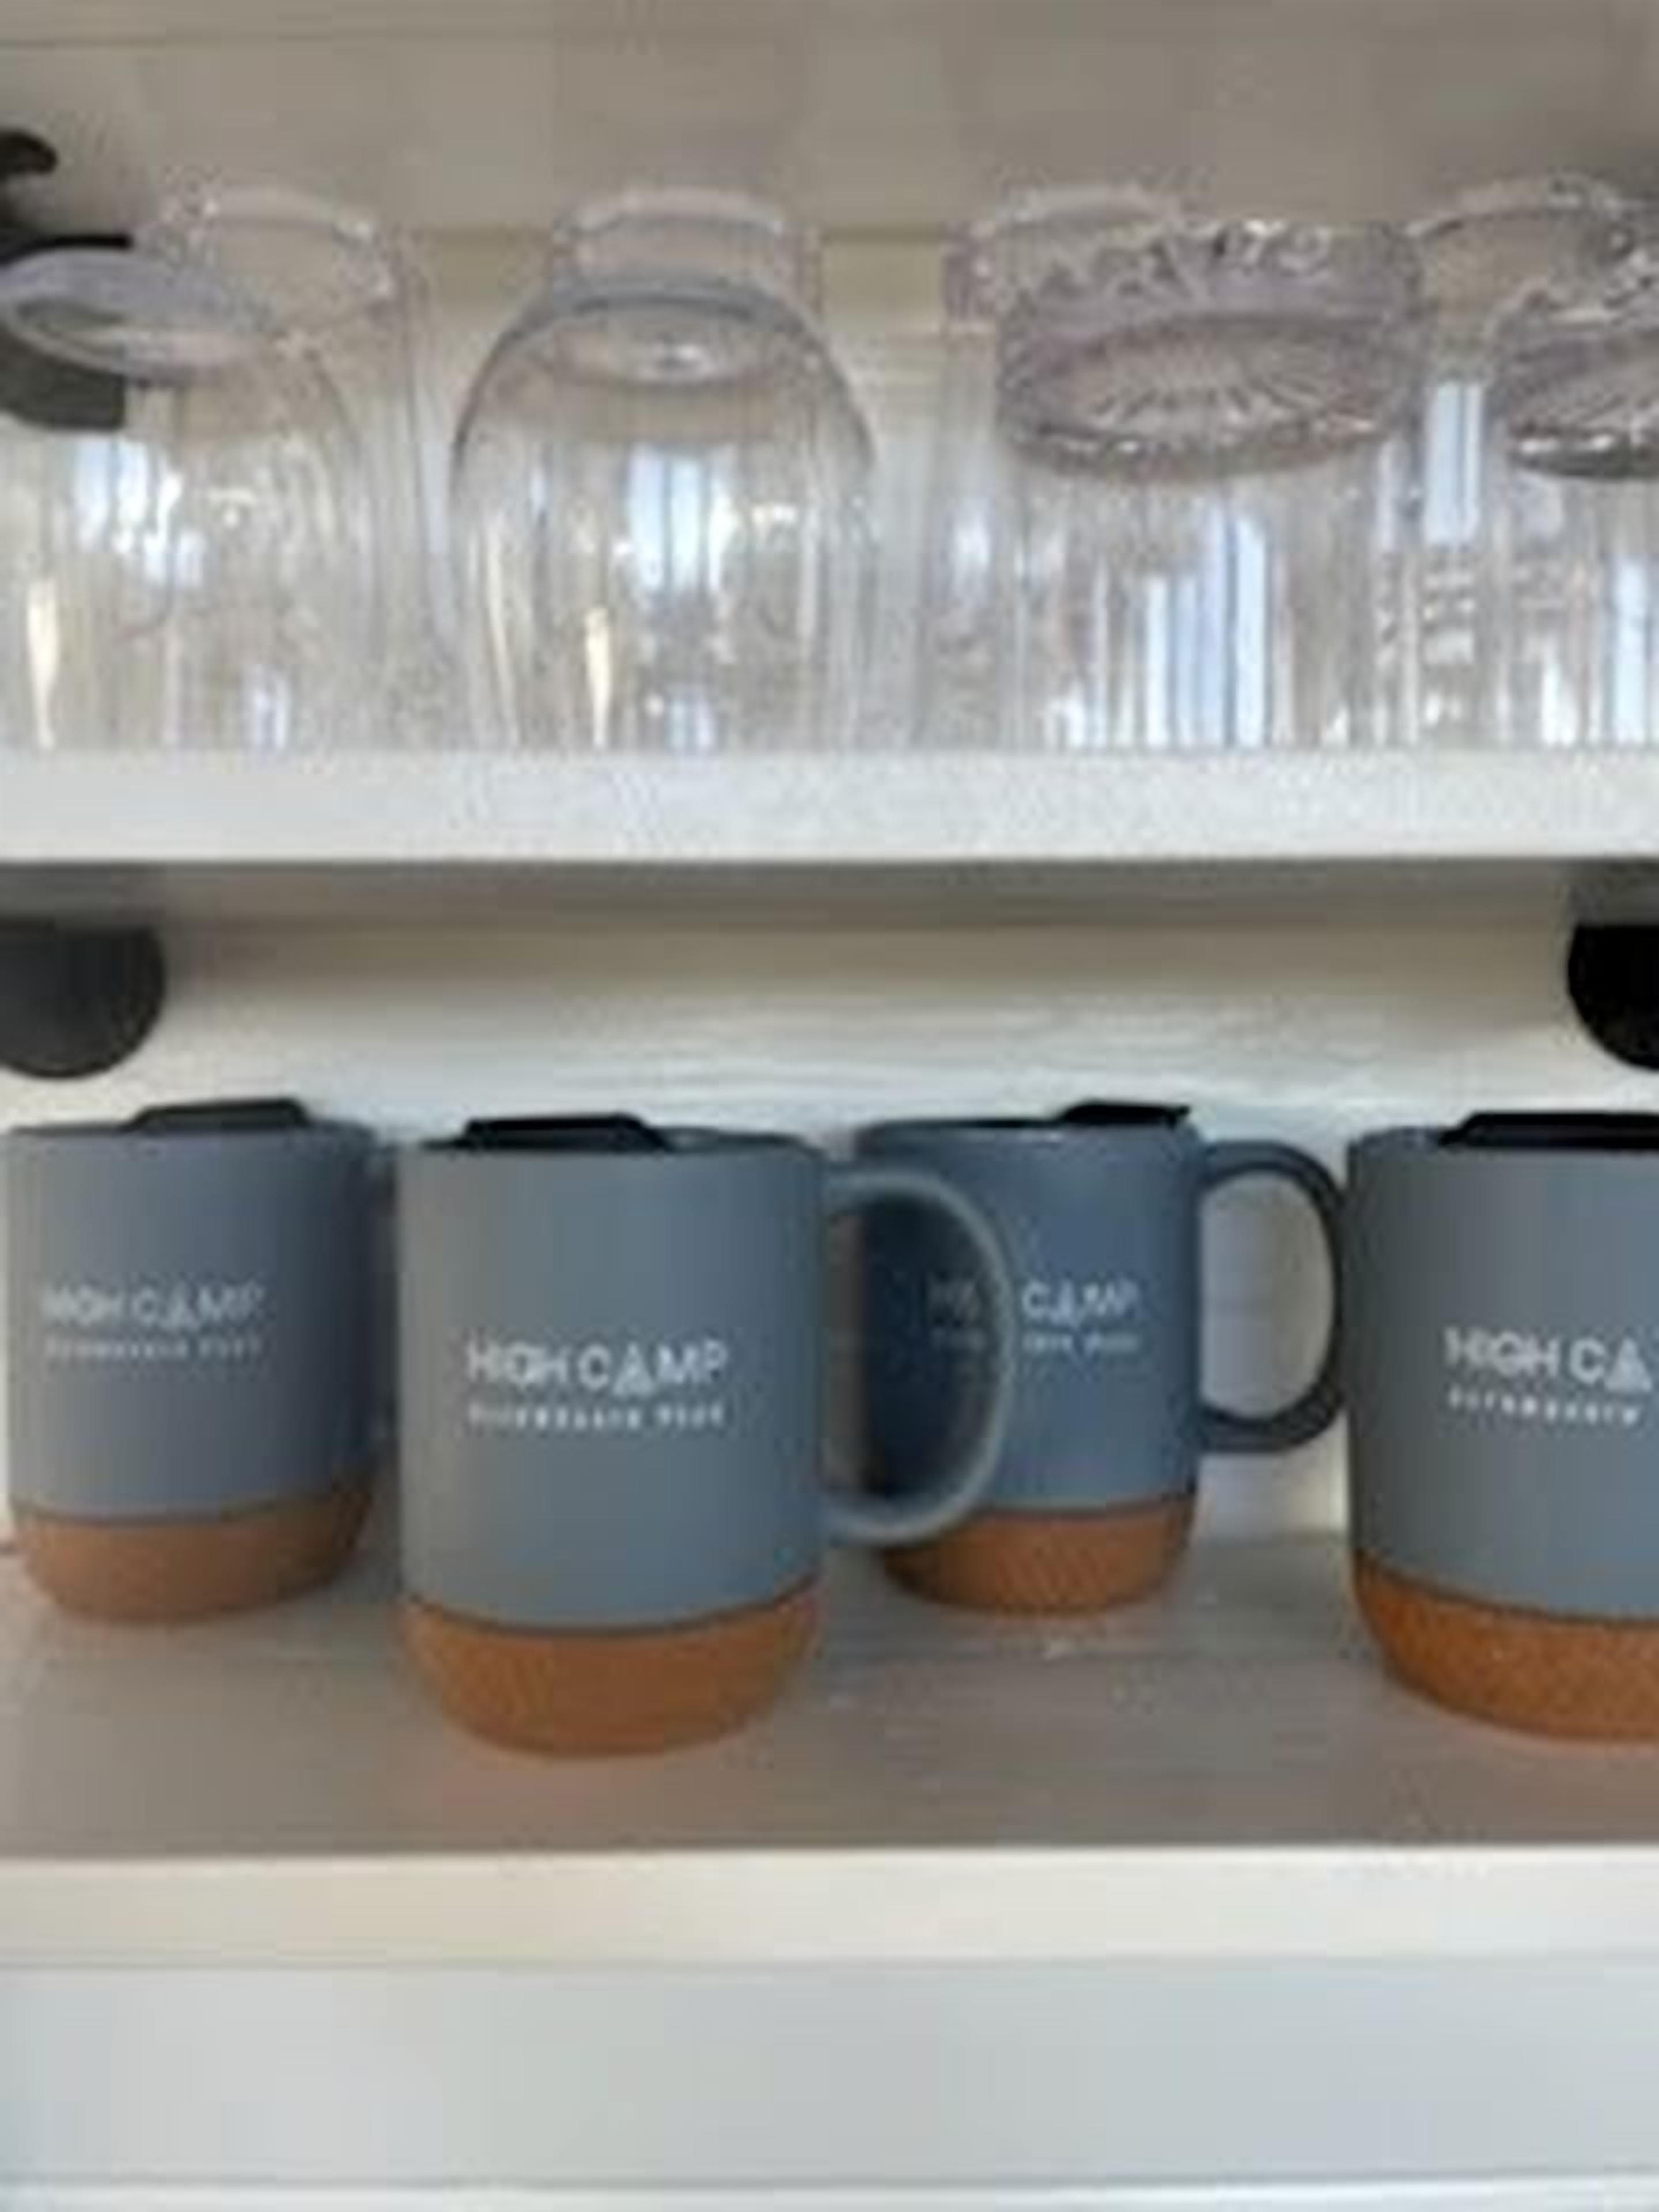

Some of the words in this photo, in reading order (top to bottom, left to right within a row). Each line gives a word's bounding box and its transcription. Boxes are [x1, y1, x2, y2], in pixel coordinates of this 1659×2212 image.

[40, 1285, 123, 1325] HIGH
[131, 1282, 267, 1330] CAMP
[1021, 1278, 1141, 1327] CAMP
[467, 1335, 570, 1384] HIGH
[578, 1339, 729, 1395] CAMP
[1444, 1327, 1559, 1378] HIGH
